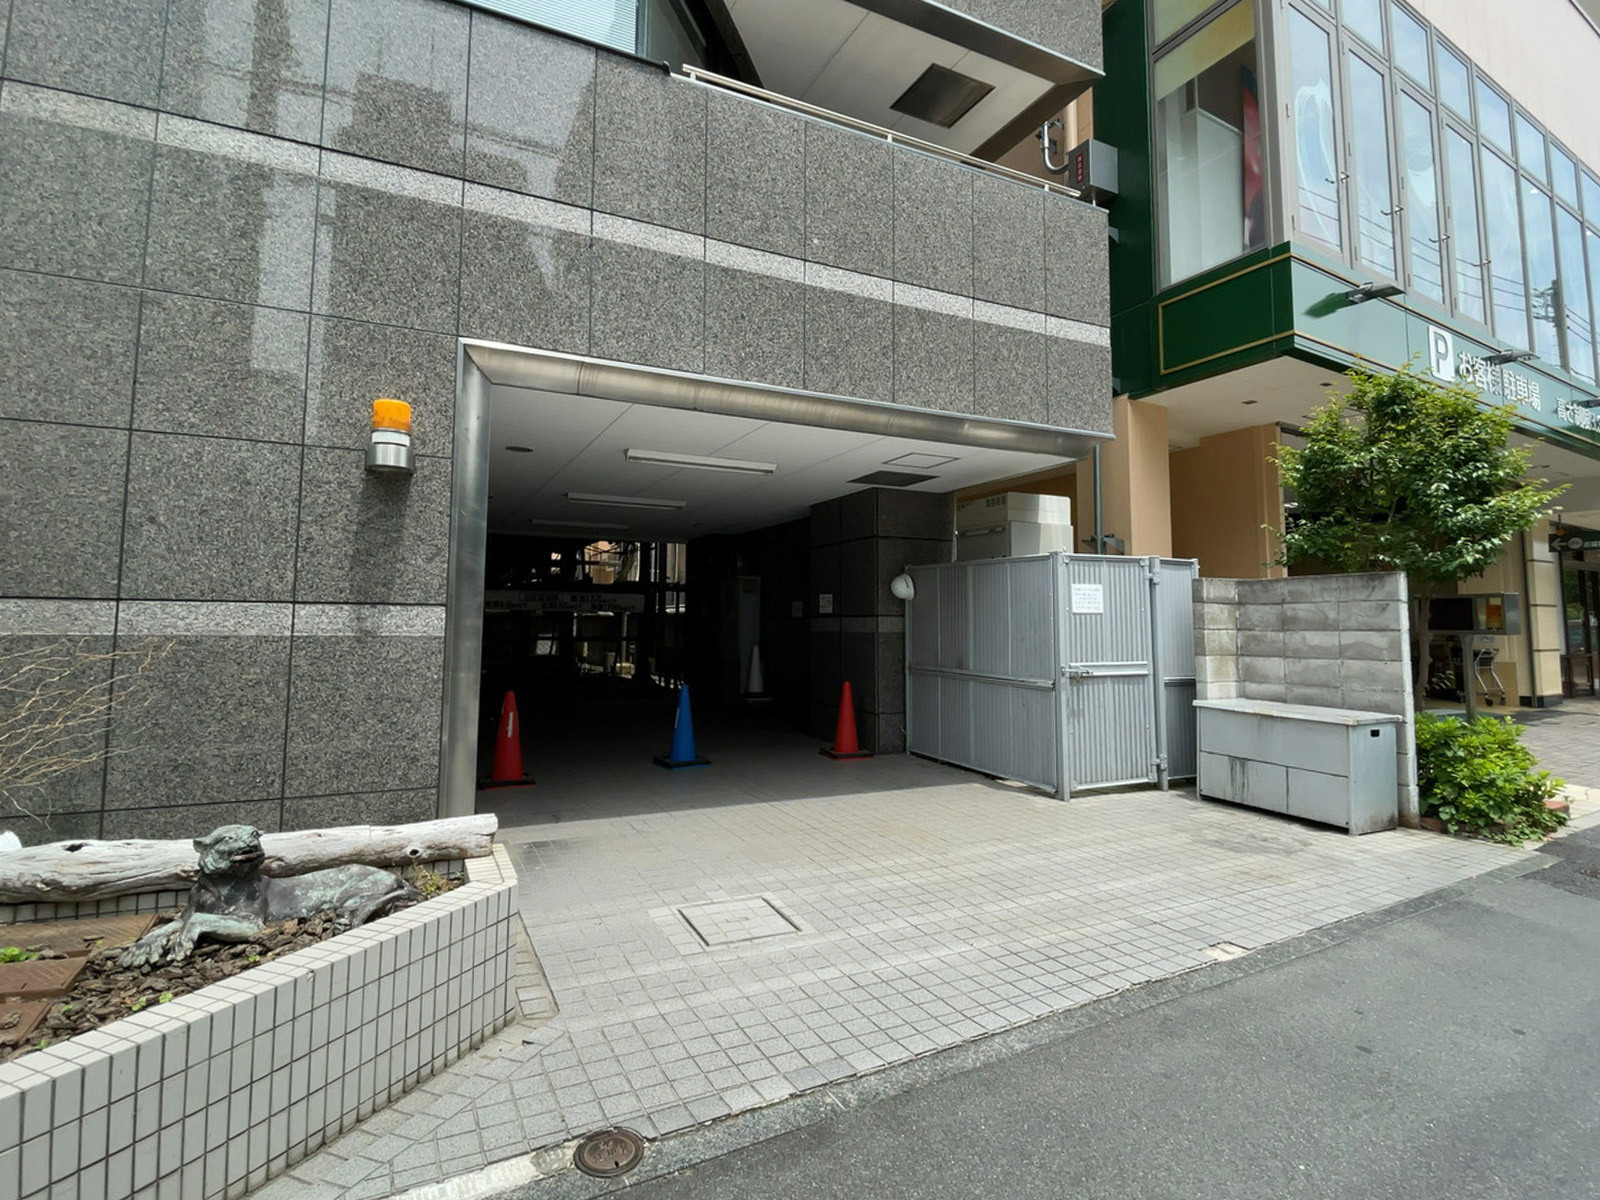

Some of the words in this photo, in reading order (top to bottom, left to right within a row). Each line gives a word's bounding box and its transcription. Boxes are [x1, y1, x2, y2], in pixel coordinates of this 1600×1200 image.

[1432, 329, 1450, 376] P
[1458, 351, 1542, 412] お客様駐車場
